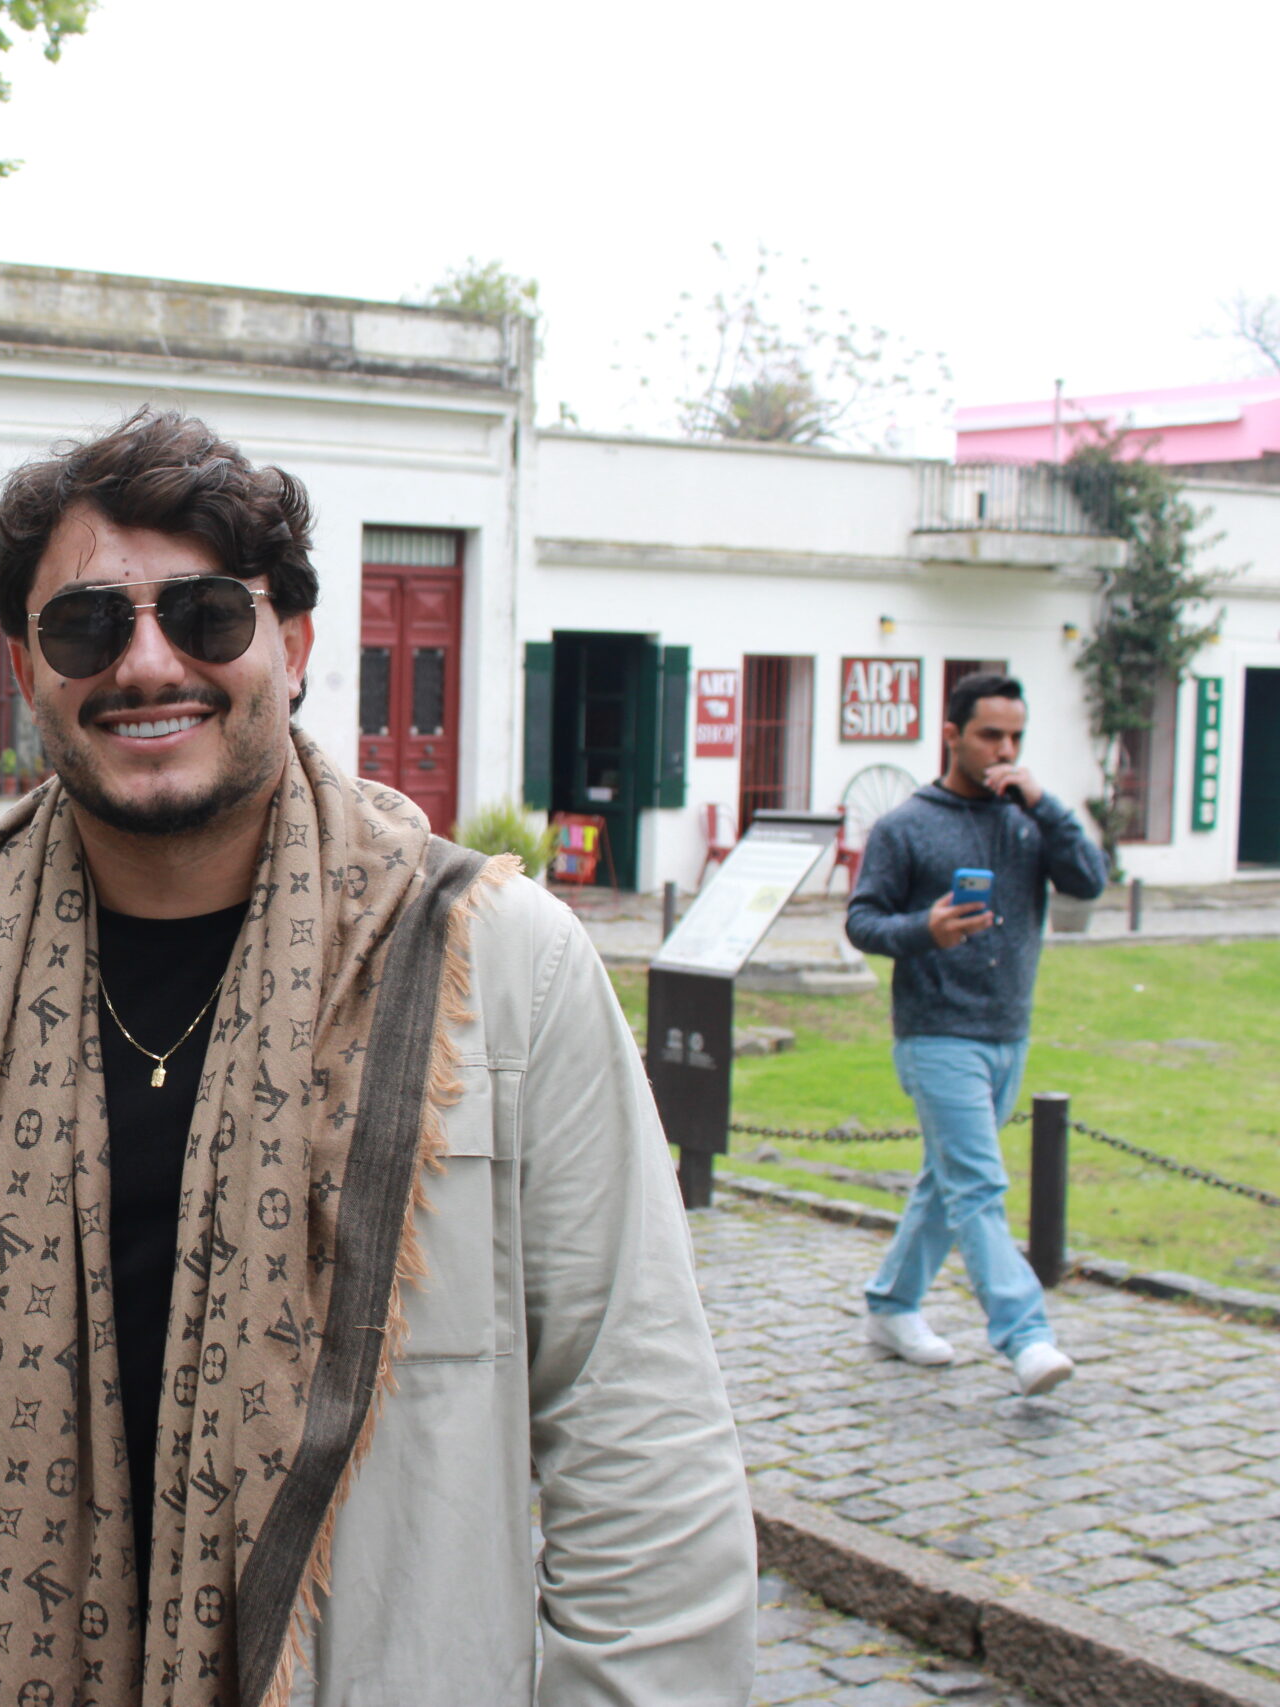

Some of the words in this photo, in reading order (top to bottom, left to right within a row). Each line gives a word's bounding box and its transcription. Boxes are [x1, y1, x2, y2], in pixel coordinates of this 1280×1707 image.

[699, 672, 737, 697] ART
[846, 660, 918, 701] ART
[696, 724, 738, 744] SHOP
[842, 703, 917, 736] SHOP
